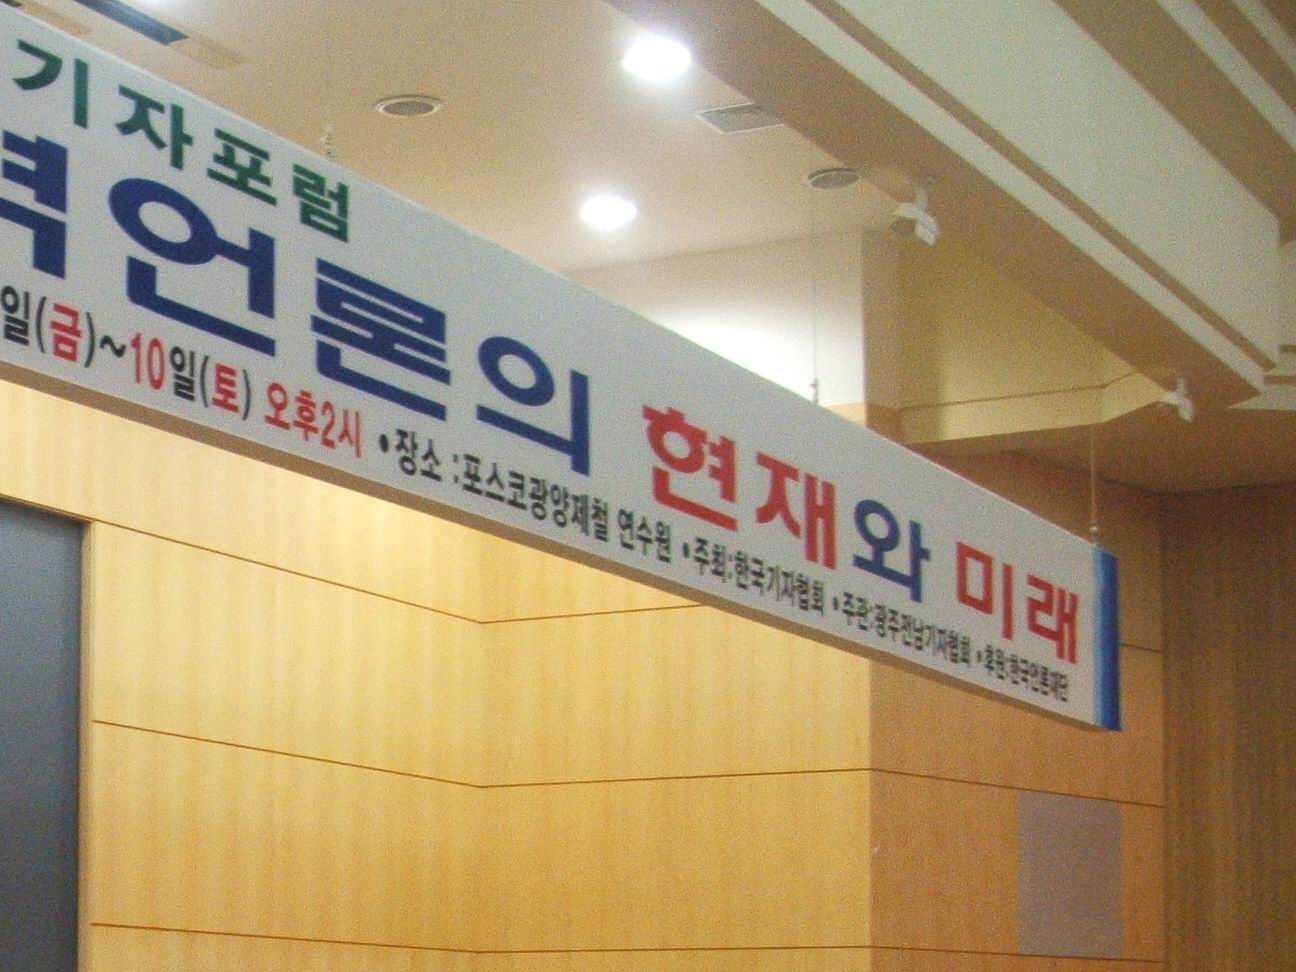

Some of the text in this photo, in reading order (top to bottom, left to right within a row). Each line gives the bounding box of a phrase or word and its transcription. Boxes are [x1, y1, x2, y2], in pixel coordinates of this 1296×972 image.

[12, 39, 349, 243] 기자포럼
[265, 383, 363, 458] 오후2시
[617, 508, 672, 563] 연수원
[642, 404, 931, 603] 현재와
[956, 542, 1079, 665] 미래
